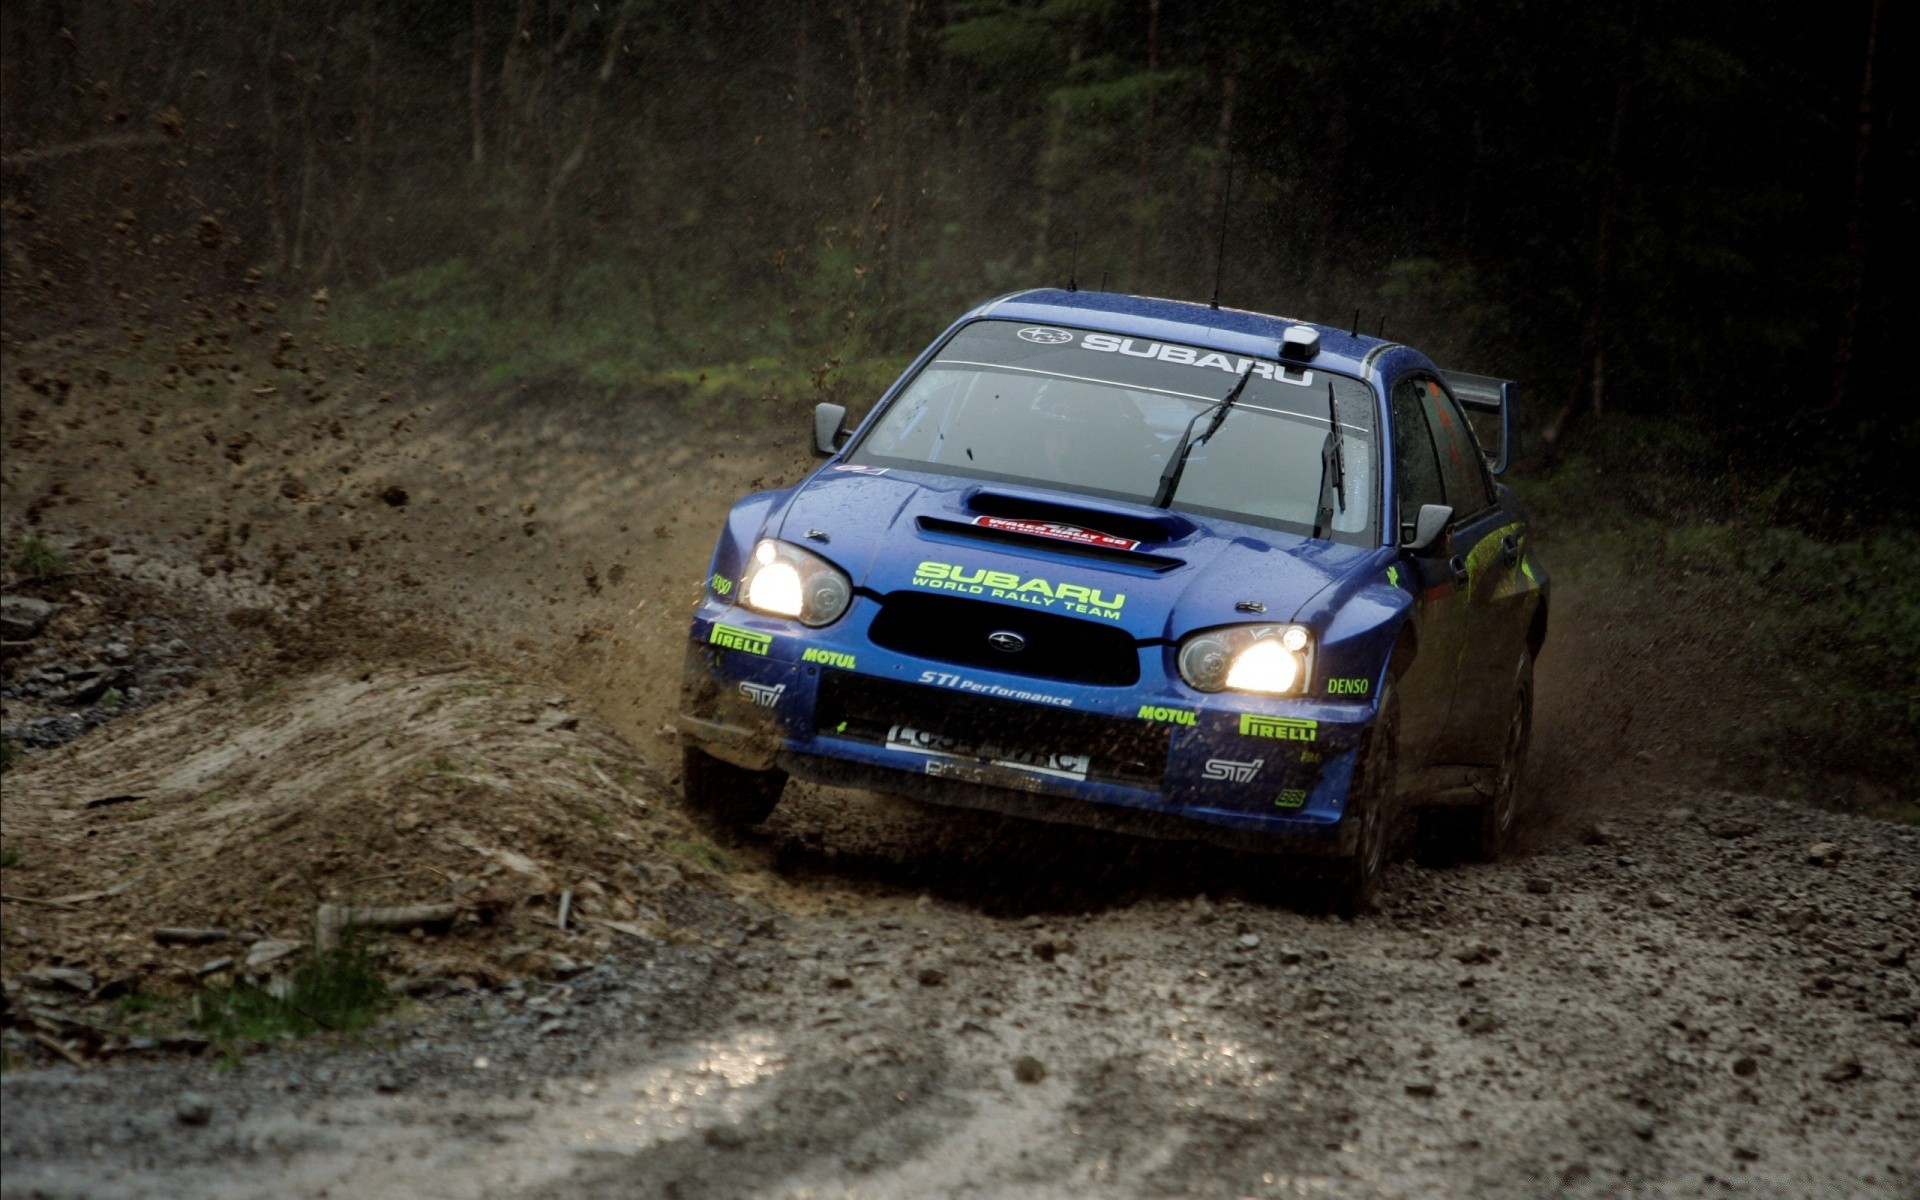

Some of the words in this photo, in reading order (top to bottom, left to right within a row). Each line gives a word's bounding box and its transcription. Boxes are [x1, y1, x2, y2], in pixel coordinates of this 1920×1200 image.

[1080, 334, 1314, 387] SUBARU
[912, 577, 984, 595] WORLD
[991, 589, 1056, 607] RALLY
[1064, 601, 1121, 621] TEAM
[914, 561, 1126, 610] SUBARU
[709, 622, 774, 656] PIRELLI
[801, 646, 856, 670] MOTUL
[917, 670, 959, 689] STI
[961, 679, 1073, 707] Performance
[1327, 678, 1369, 695] DENSO
[1137, 705, 1198, 727] MOTUL
[1239, 713, 1318, 742] PIRELLI
